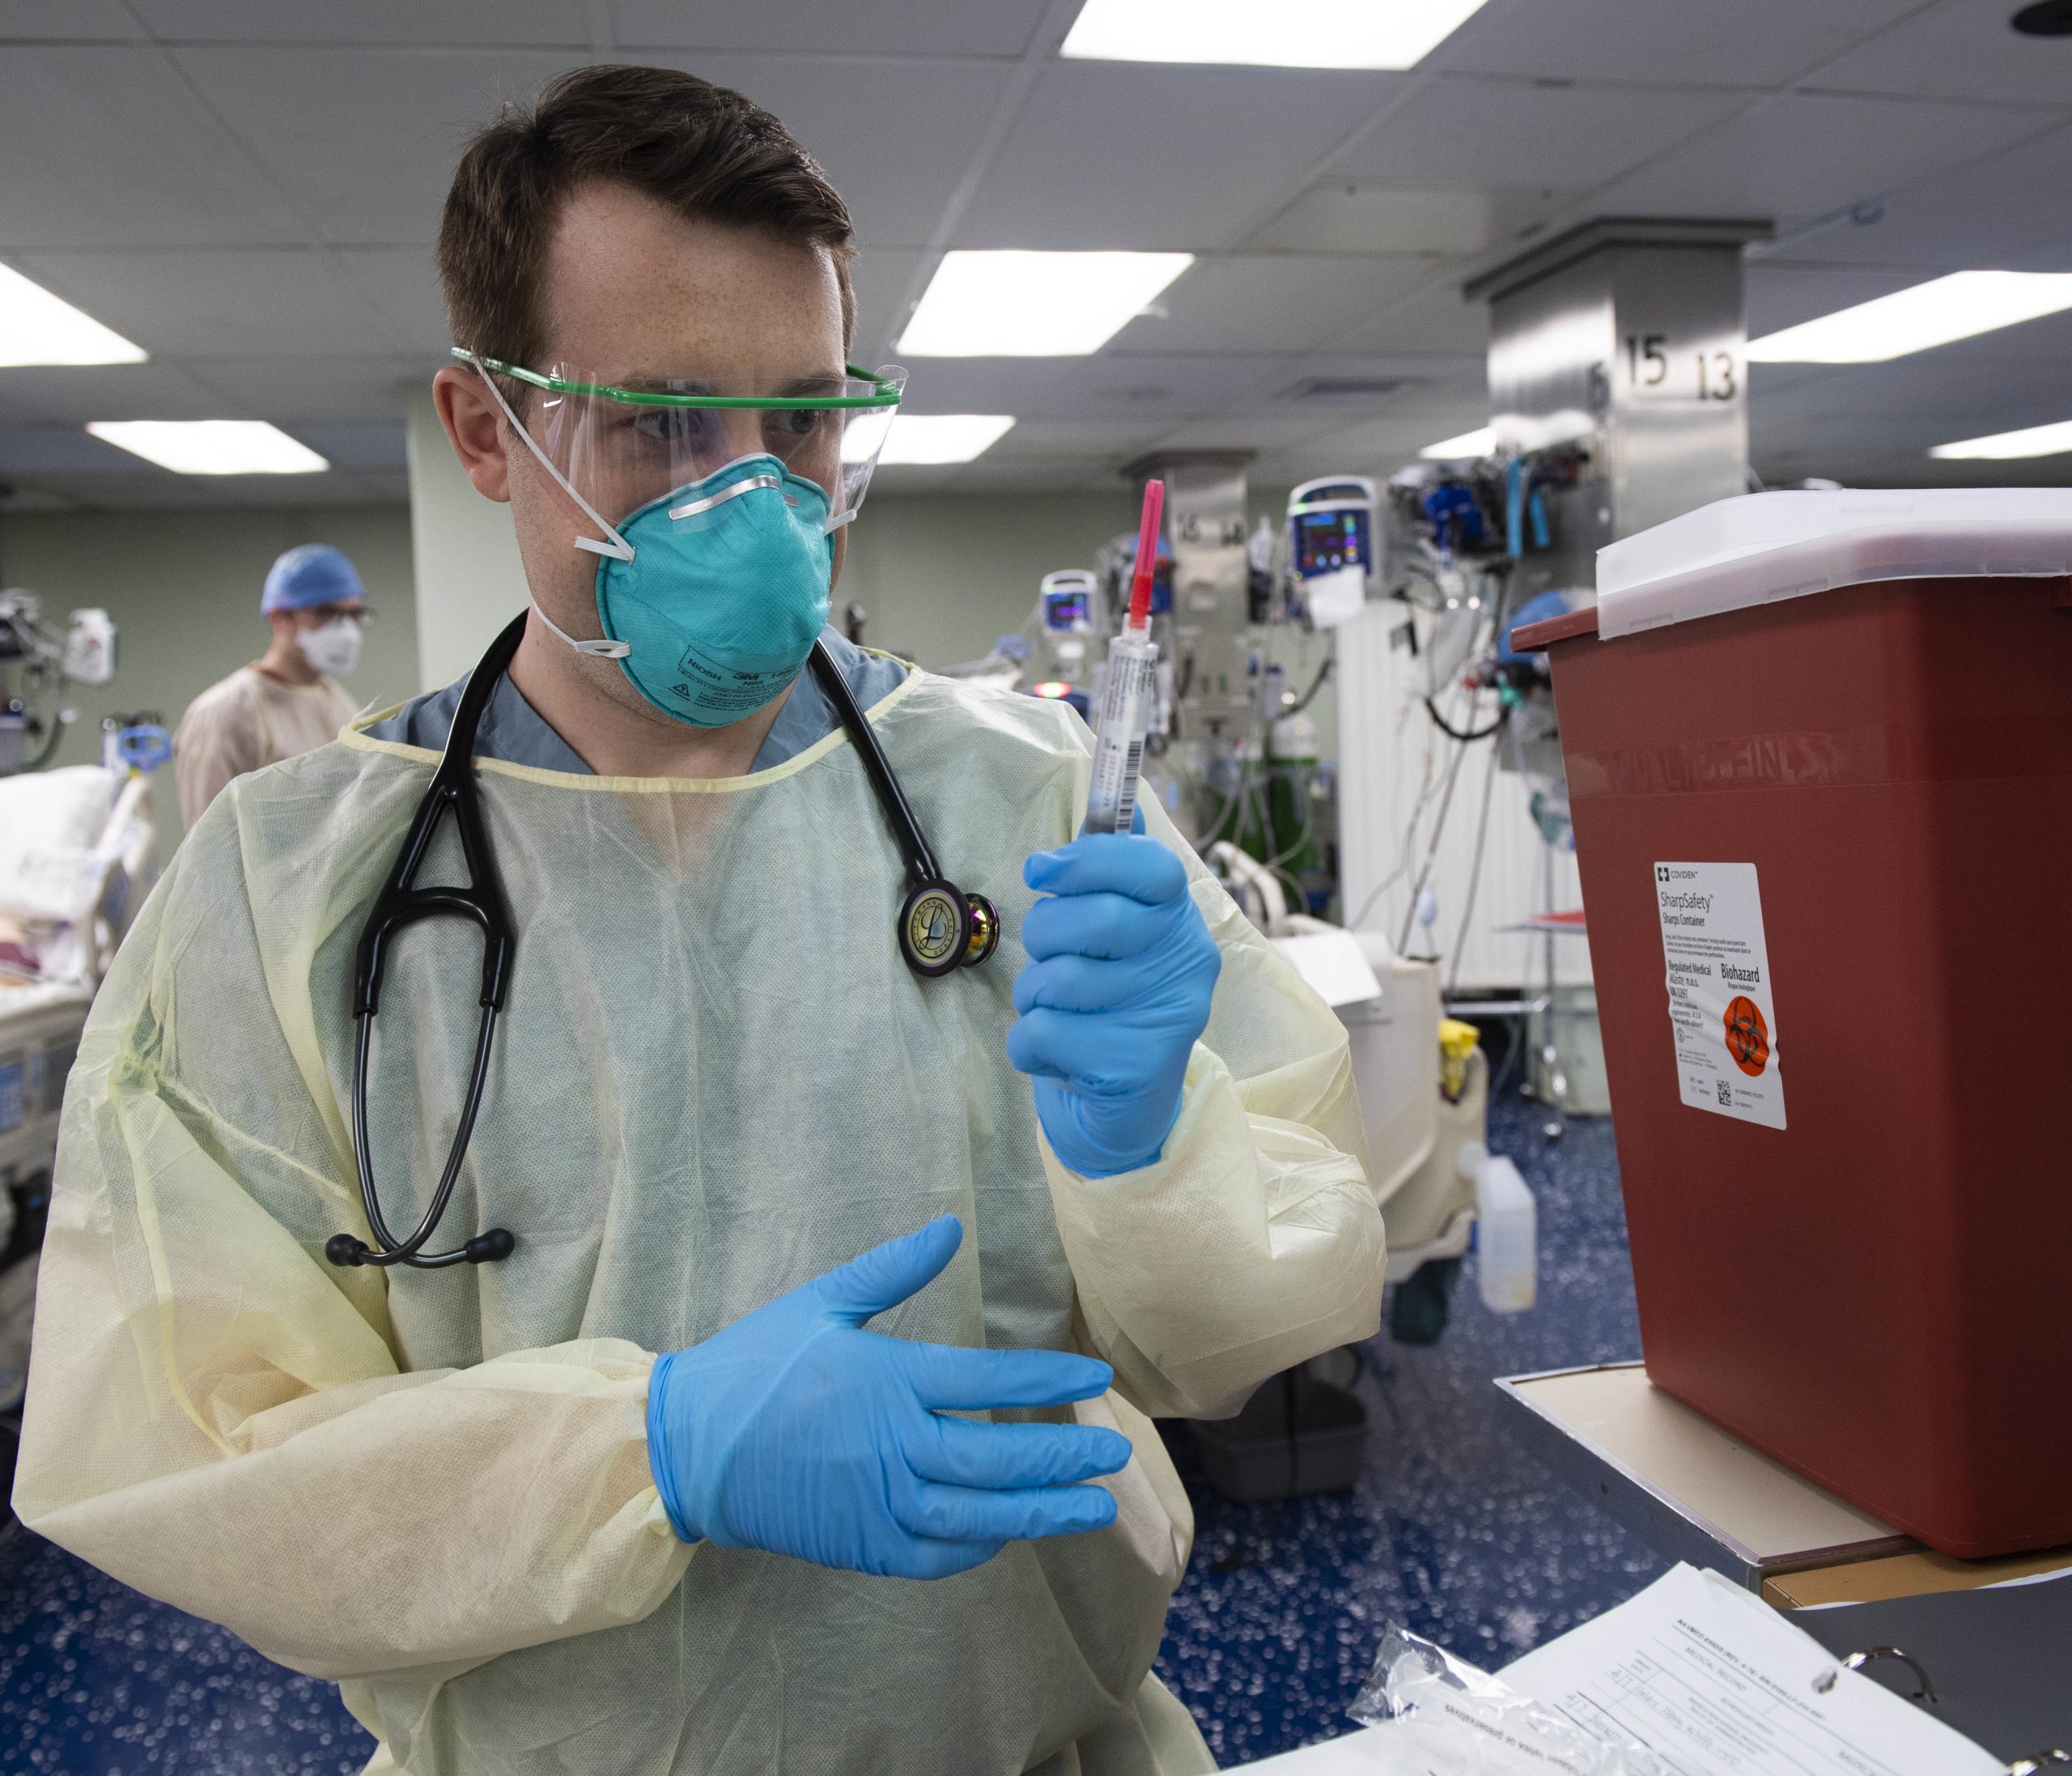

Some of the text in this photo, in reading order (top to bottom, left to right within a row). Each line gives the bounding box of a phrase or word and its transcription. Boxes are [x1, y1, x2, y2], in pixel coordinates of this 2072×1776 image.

[1626, 334, 1735, 401] 15 13
[688, 658, 722, 682] NIOSH
[733, 672, 761, 681] 3M
[1662, 913, 1705, 927] Sharps Container
[1668, 960, 1712, 975] Regulated Medical
[1721, 963, 1760, 983] Biohazard
[1678, 1619, 1705, 1639] NAVMED
[1685, 1646, 1747, 1692] MEDICAL RECORD
[1444, 1704, 1504, 1740] preservatives
[1505, 1736, 1516, 1746] or
